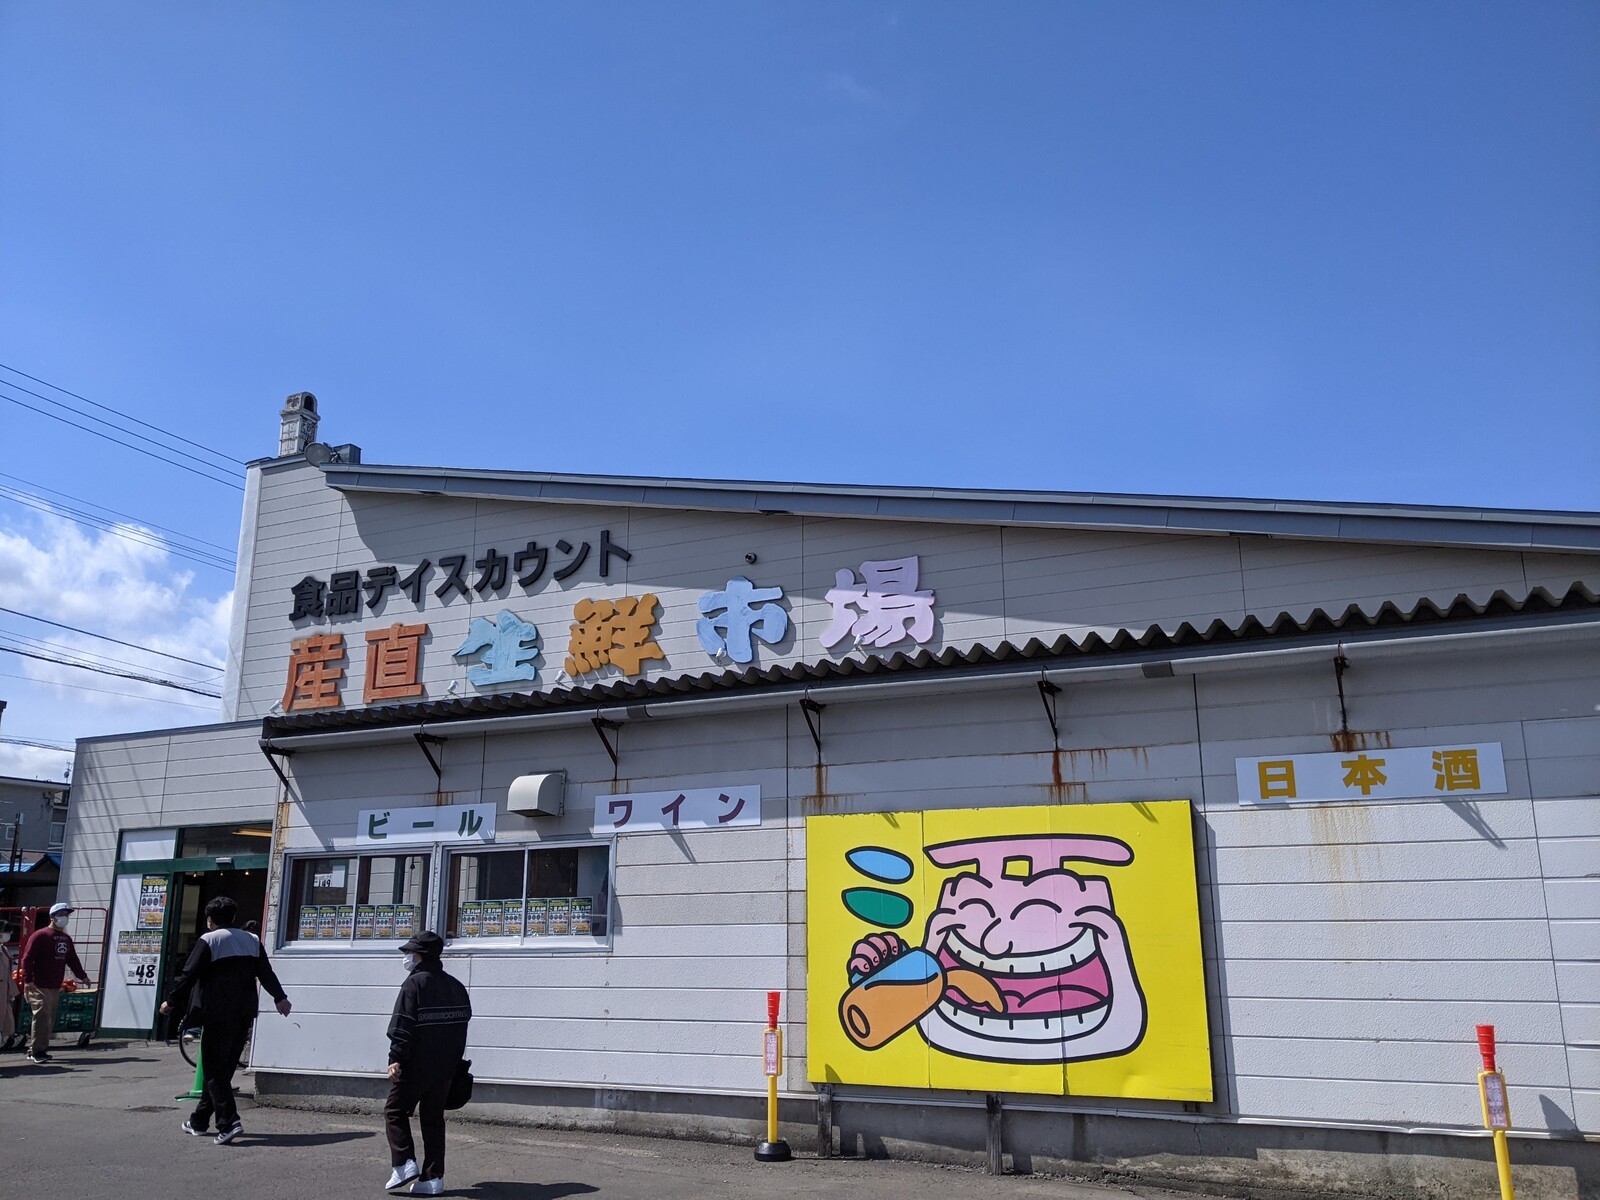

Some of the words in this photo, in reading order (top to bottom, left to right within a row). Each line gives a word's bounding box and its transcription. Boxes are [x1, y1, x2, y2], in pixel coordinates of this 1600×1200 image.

[282, 556, 935, 713] 産直生鮮市場
[1257, 749, 1481, 799] 日本酒
[368, 808, 483, 841] ビール
[608, 793, 746, 829] ワイン
[135, 964, 156, 978] 48
